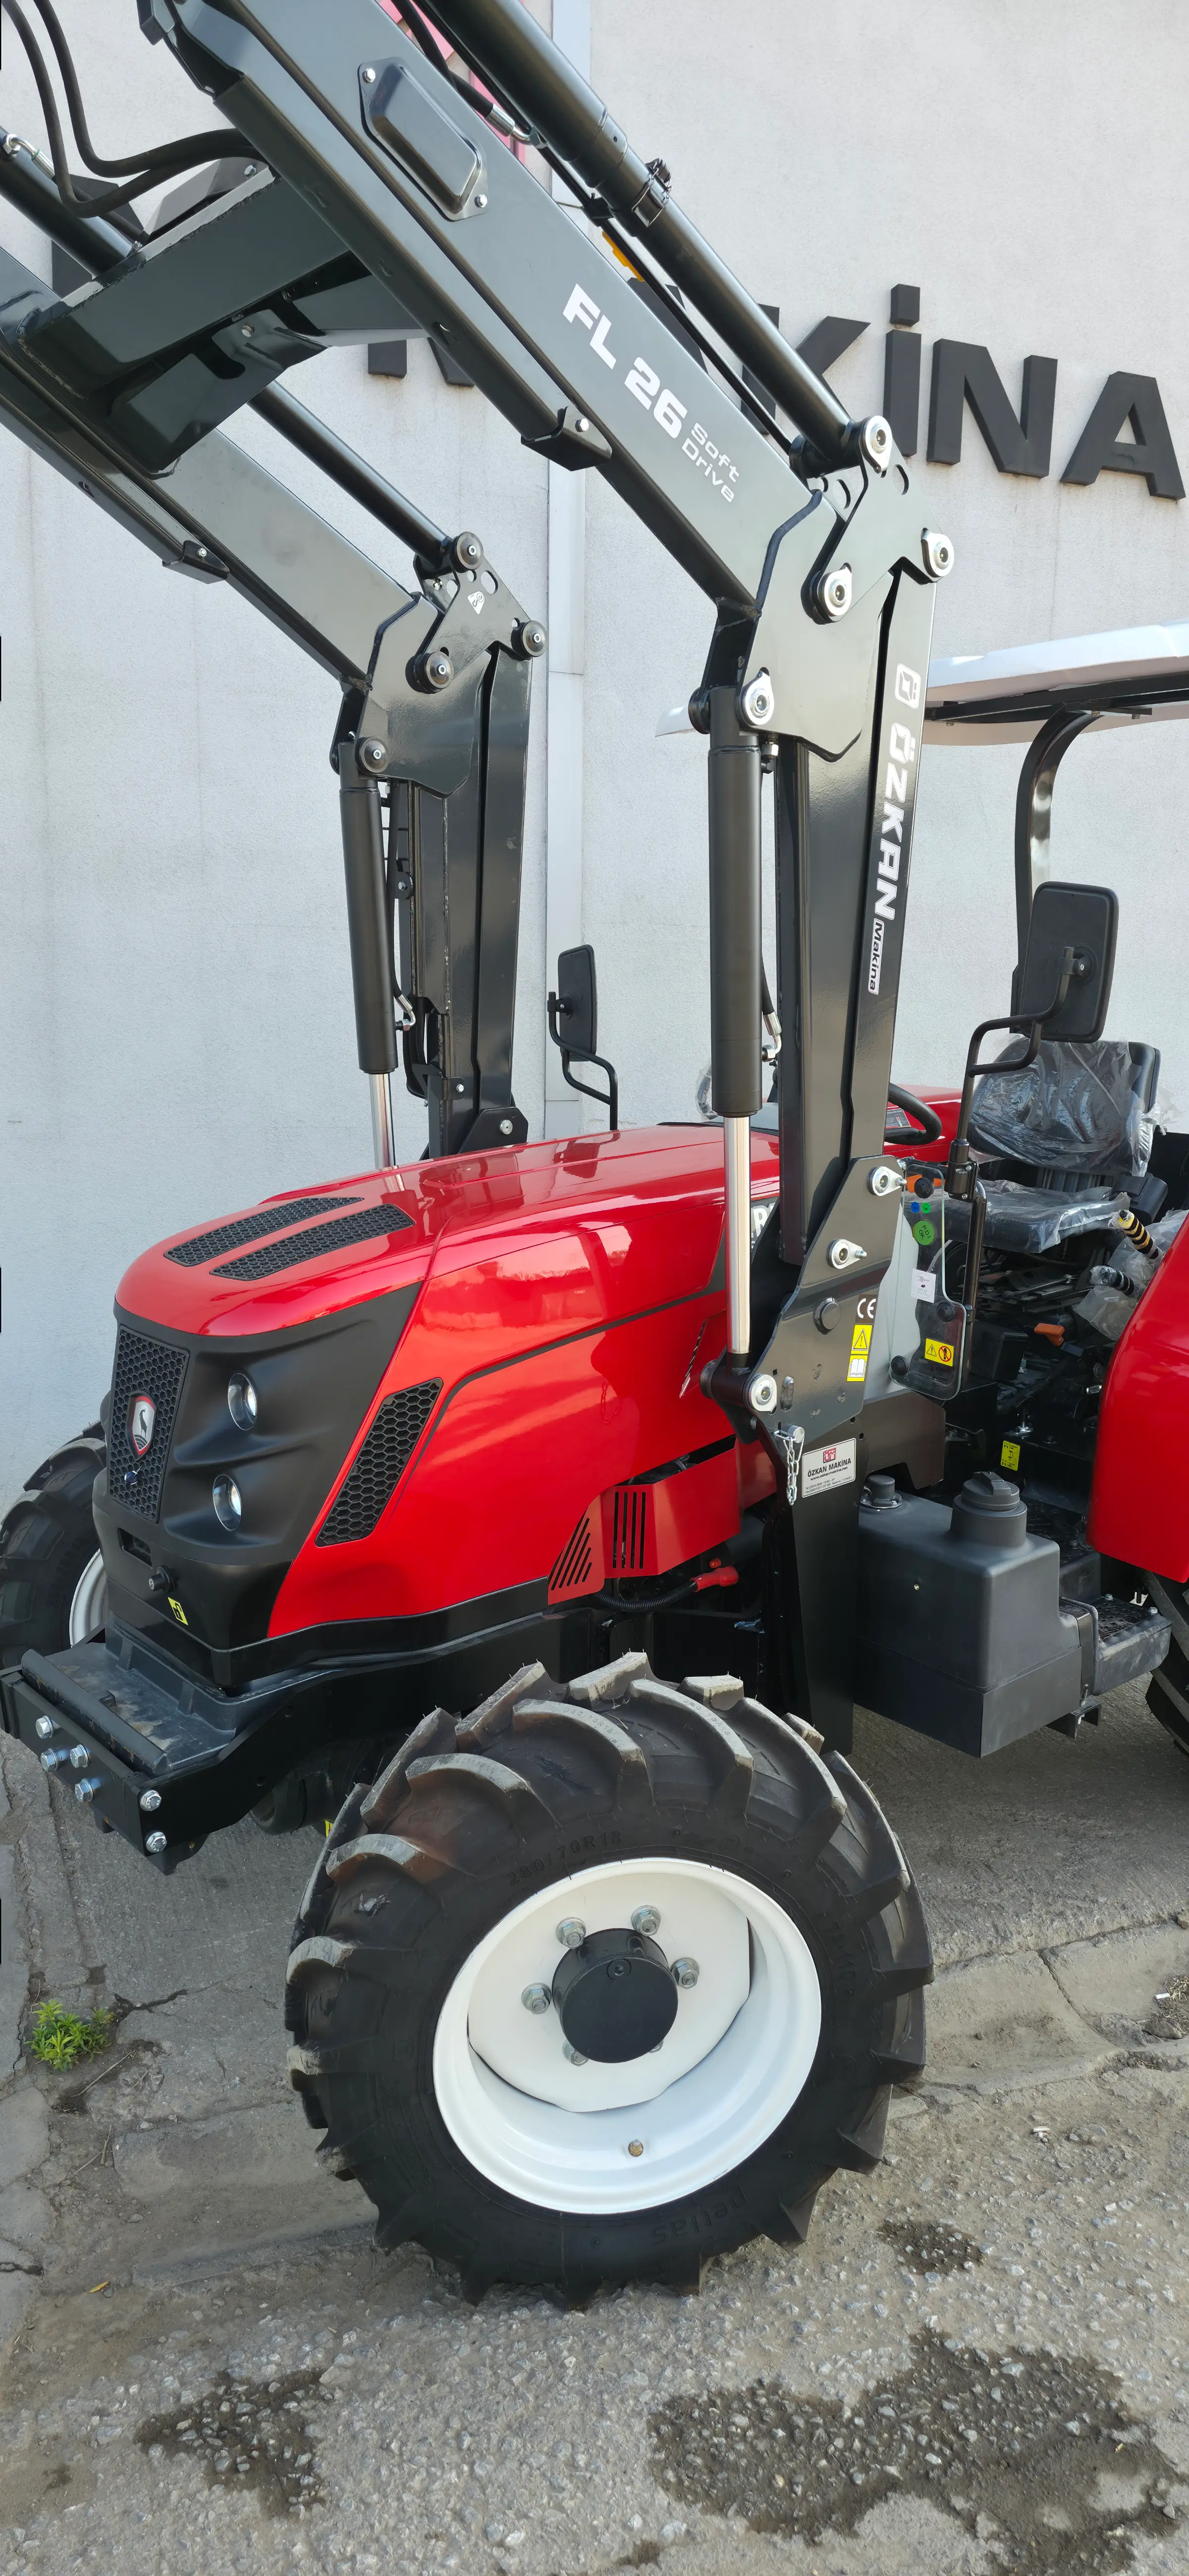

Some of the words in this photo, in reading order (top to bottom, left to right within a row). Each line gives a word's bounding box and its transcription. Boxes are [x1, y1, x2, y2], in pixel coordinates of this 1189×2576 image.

[563, 283, 616, 369] FL
[624, 357, 688, 439] 26
[681, 437, 735, 502] Drive
[691, 422, 740, 483] Soft
[875, 722, 916, 920] ÖZKAN
[869, 922, 883, 991] Makina
[808, 1465, 827, 1477] ÖZKAN
[829, 1458, 851, 1470] MAKİNA
[811, 1466, 848, 1481] www.ozkanmakina.net
